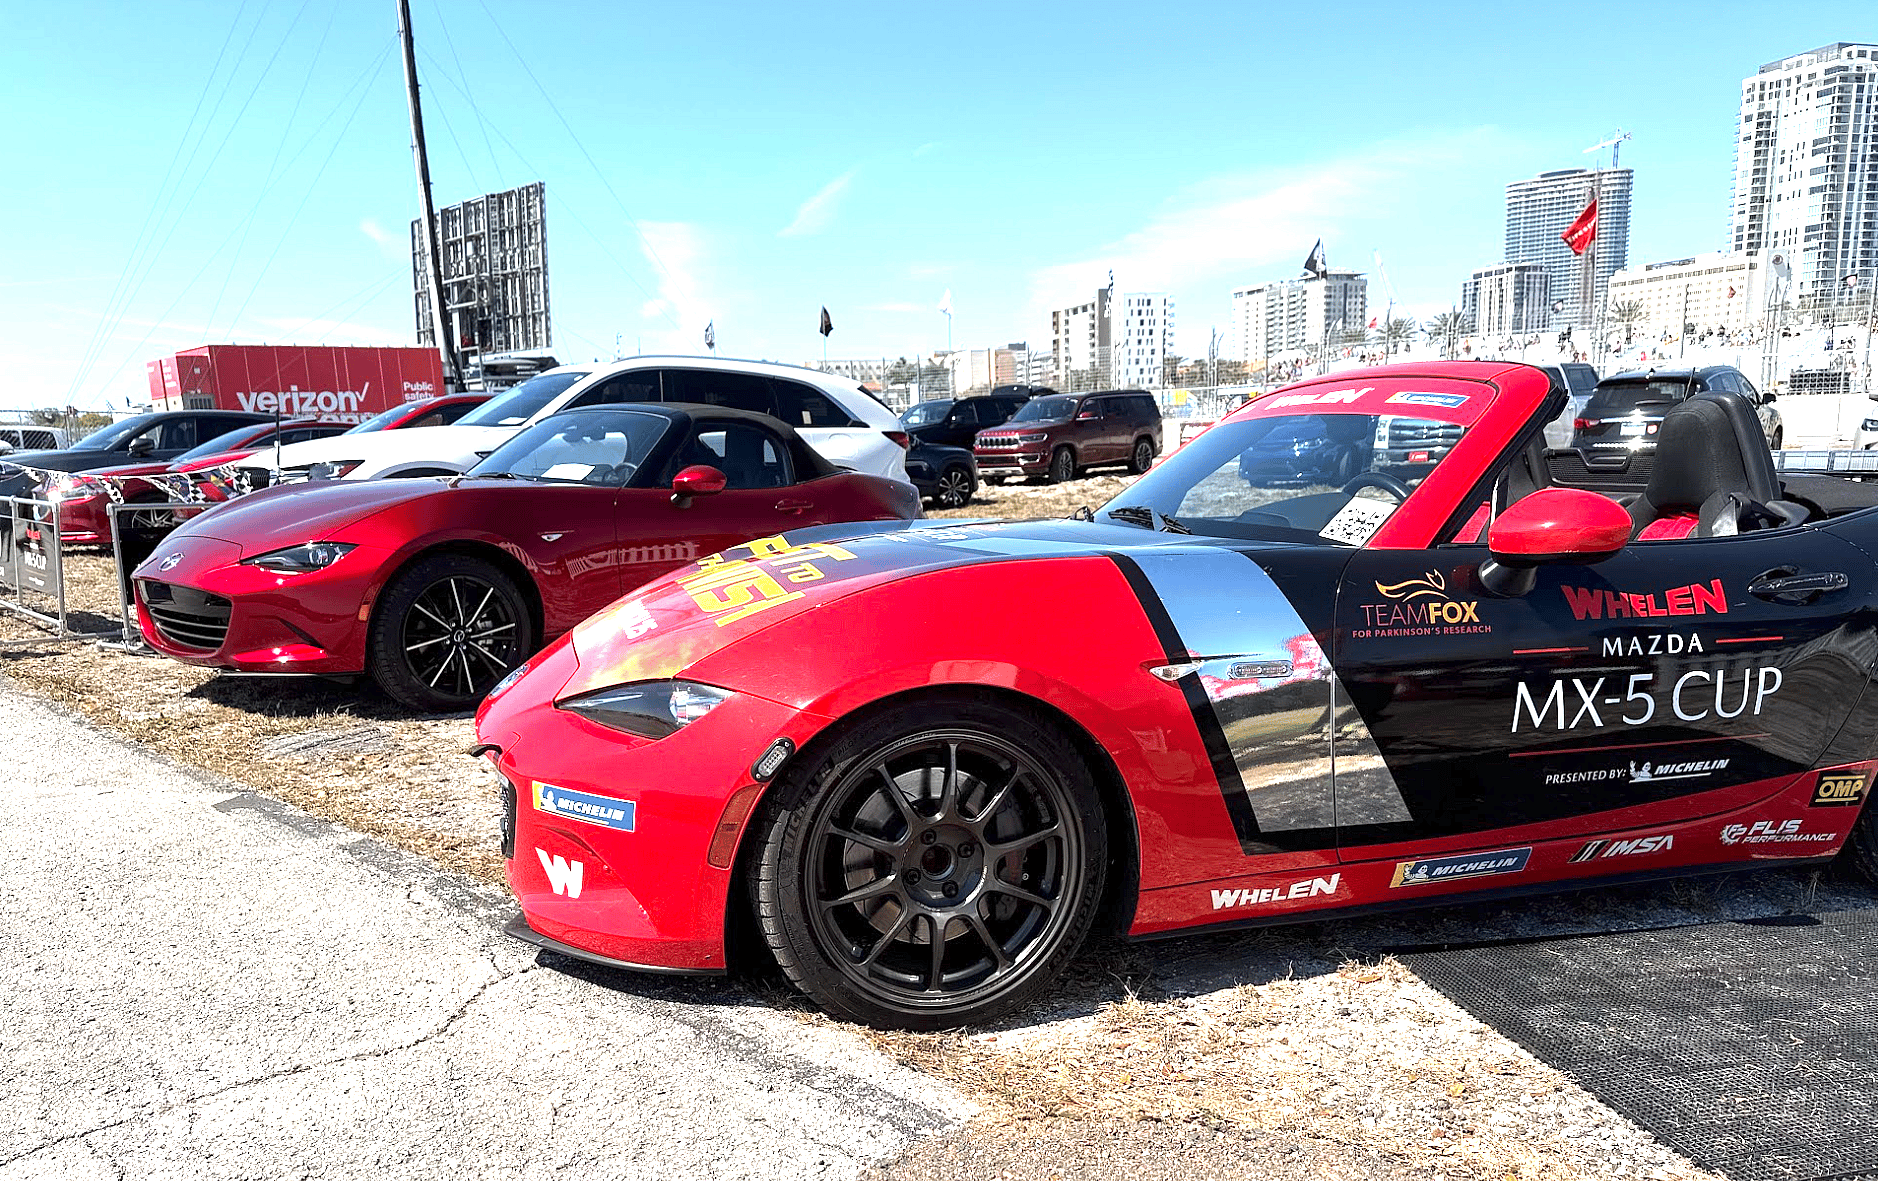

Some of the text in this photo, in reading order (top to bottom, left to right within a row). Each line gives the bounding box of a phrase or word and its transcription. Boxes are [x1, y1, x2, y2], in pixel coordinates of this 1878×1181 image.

[403, 381, 434, 392] Public
[236, 384, 358, 415] verizon
[1560, 578, 1729, 620] WHELEN
[1352, 625, 1492, 639] FOR PARKINSON'S RESEARCH
[1602, 632, 1704, 658] MAZDA
[1511, 666, 1783, 733] MX-5 CUP
[1545, 758, 1730, 785] PRESENTED BY: MICHELIN
[1818, 779, 1864, 798] OMP
[557, 797, 626, 822] MICHELIN
[1741, 833, 1837, 844] PERFORMANCE
[1748, 820, 1804, 836] FLIS
[1602, 835, 1675, 858] IMSA
[534, 846, 584, 899] W
[1431, 857, 1517, 877] MICHELIN
[1210, 873, 1341, 910] WHELEN
